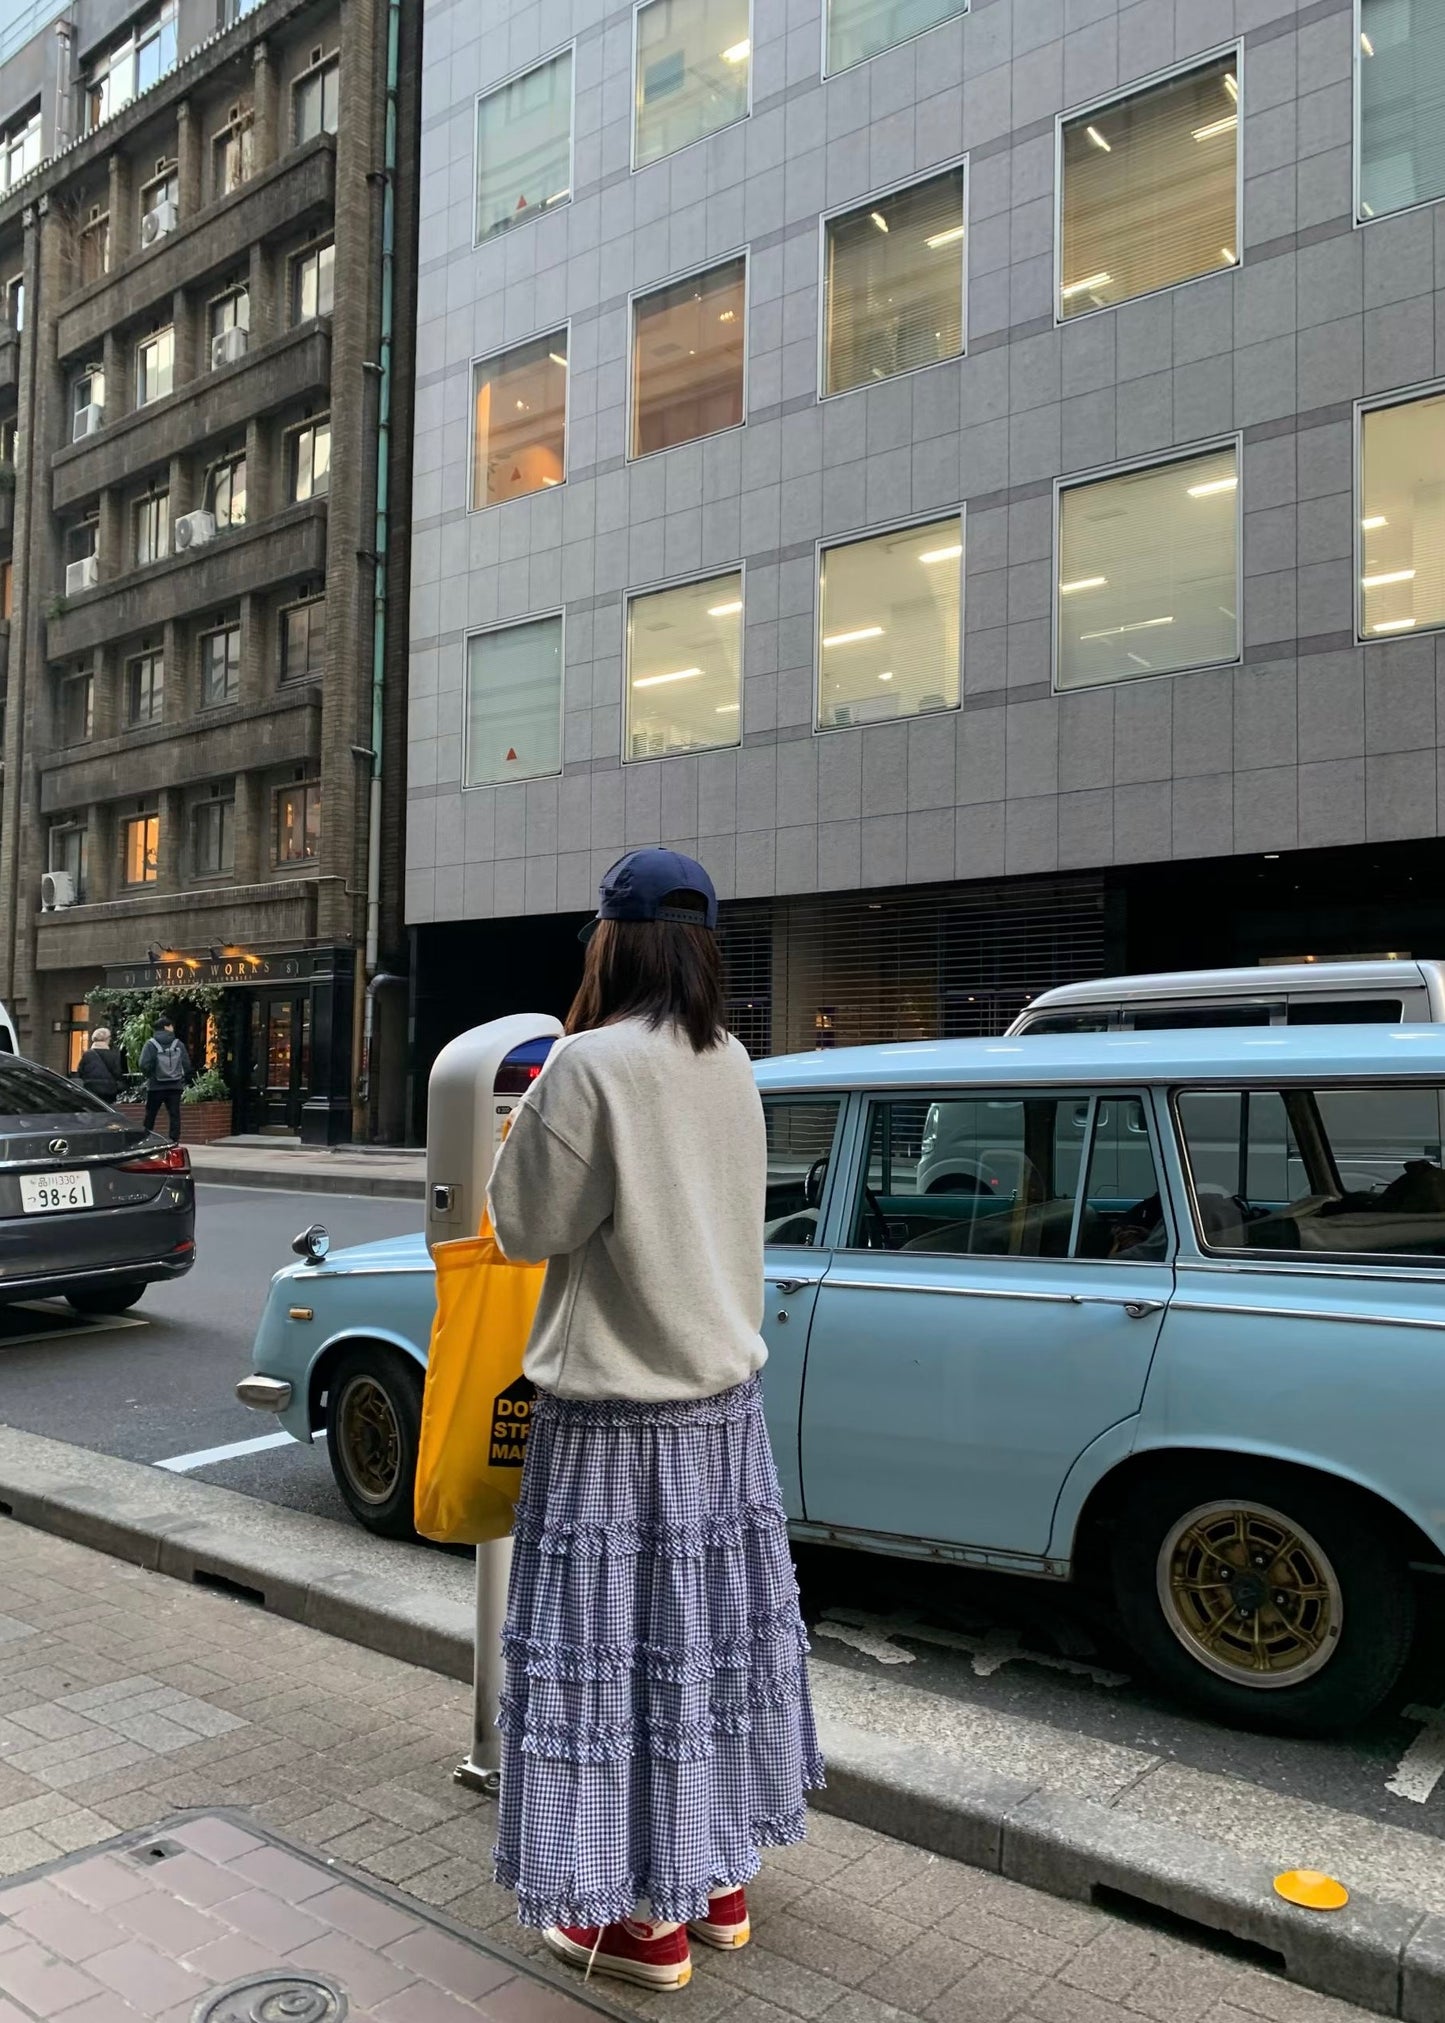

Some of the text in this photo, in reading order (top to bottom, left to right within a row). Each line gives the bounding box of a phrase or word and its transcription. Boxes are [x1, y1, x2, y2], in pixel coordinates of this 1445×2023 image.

[144, 967, 197, 981] UNION
[210, 961, 270, 976] WORKS
[38, 1186, 87, 1207] 98-61
